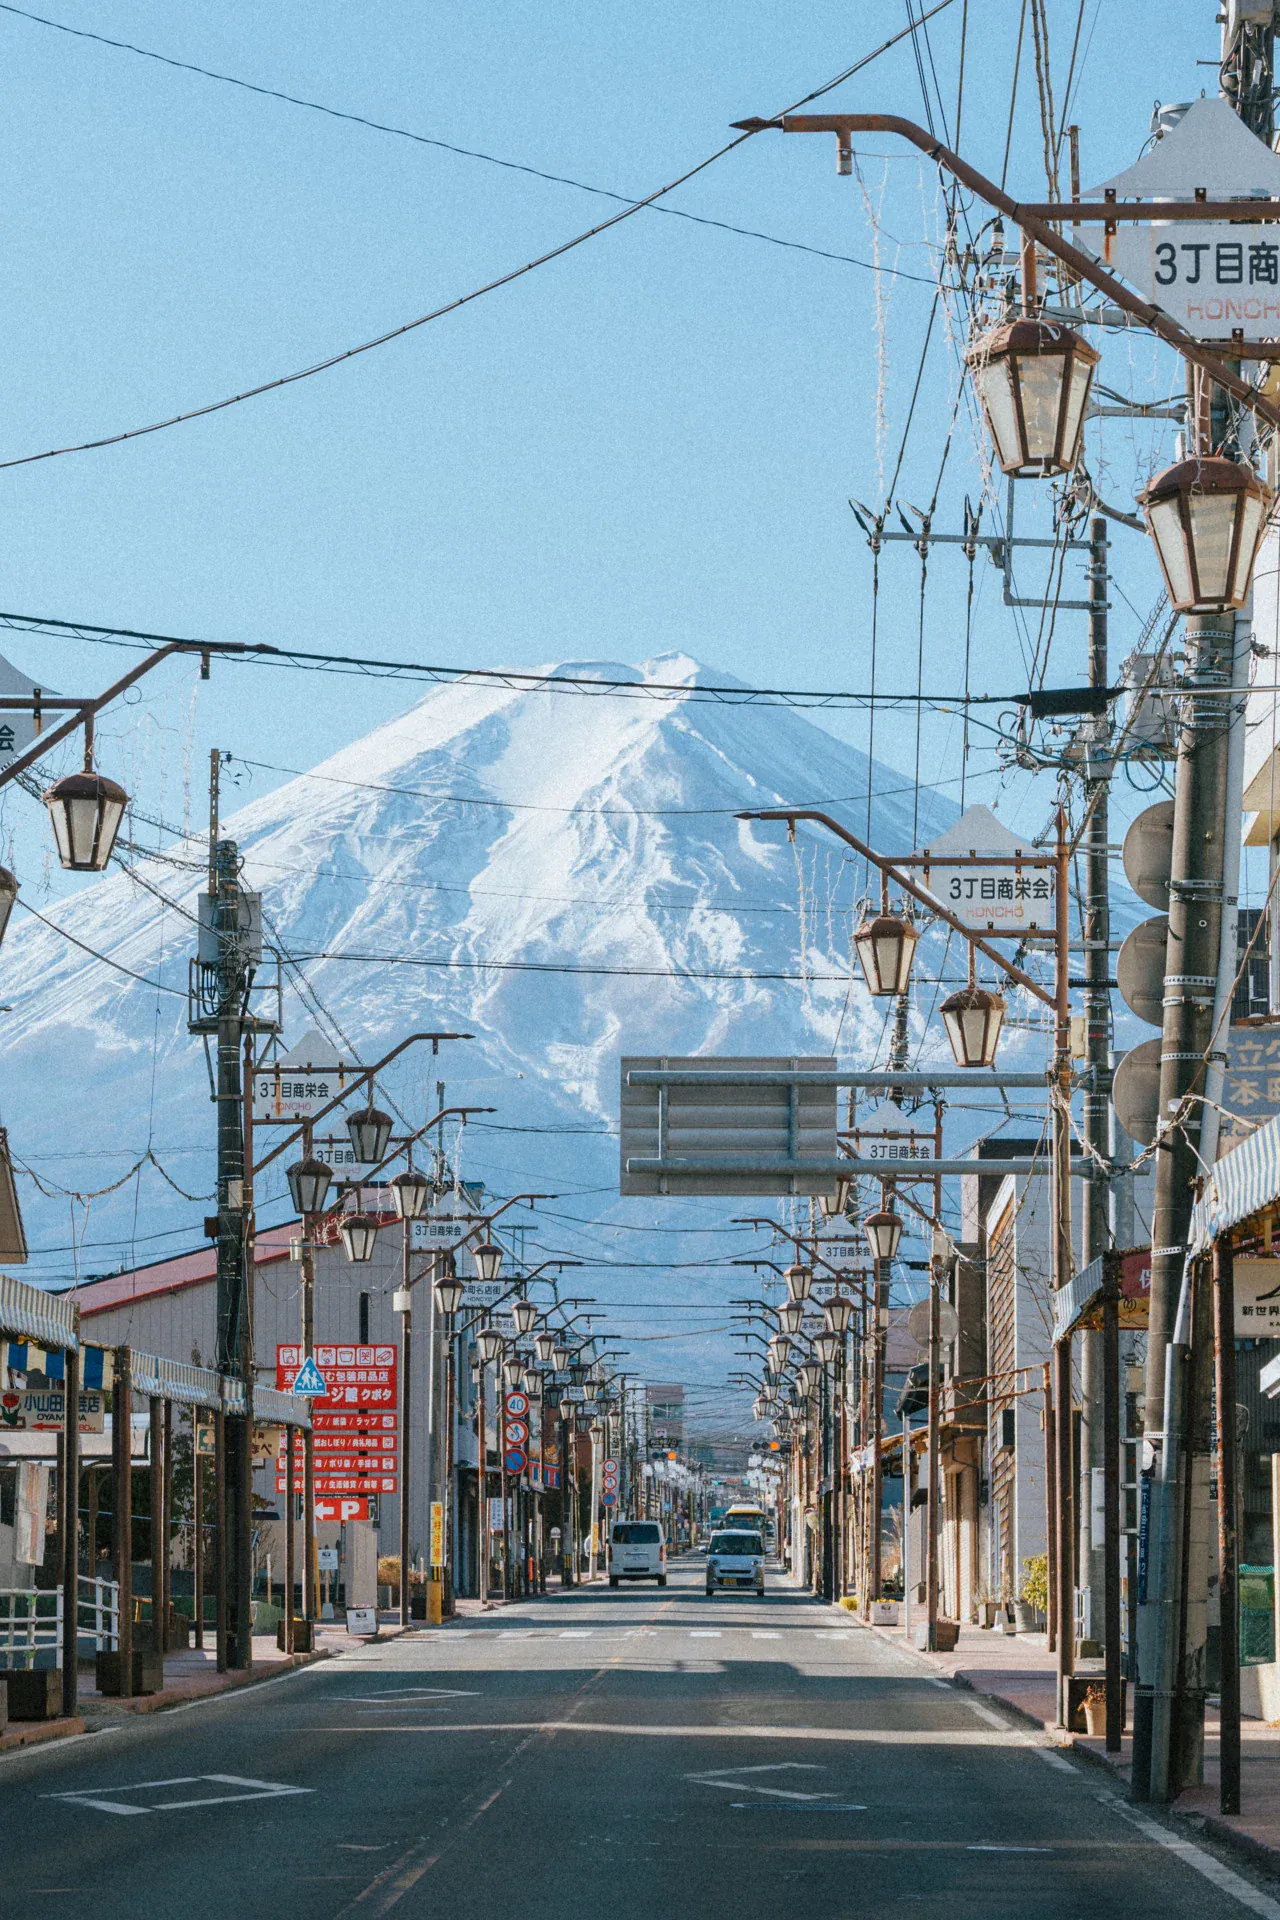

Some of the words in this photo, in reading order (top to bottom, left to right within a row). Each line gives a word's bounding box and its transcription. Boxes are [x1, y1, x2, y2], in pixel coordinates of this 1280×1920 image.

[1154, 241, 1280, 286] 3丁目商
[949, 877, 1049, 900] 3丁目商栄会
[966, 906, 1024, 918] HONCHO
[260, 1082, 329, 1099] 3丁目商栄会
[271, 1102, 312, 1111] HONCHO
[870, 1144, 930, 1159] 3丁目商栄会
[415, 1224, 462, 1237] 3丁目商栄会
[826, 1246, 871, 1257] 3丁目商栄会
[24, 1394, 100, 1413] 小山田芸店
[509, 1399, 524, 1411] 40
[341, 1501, 360, 1520] P
